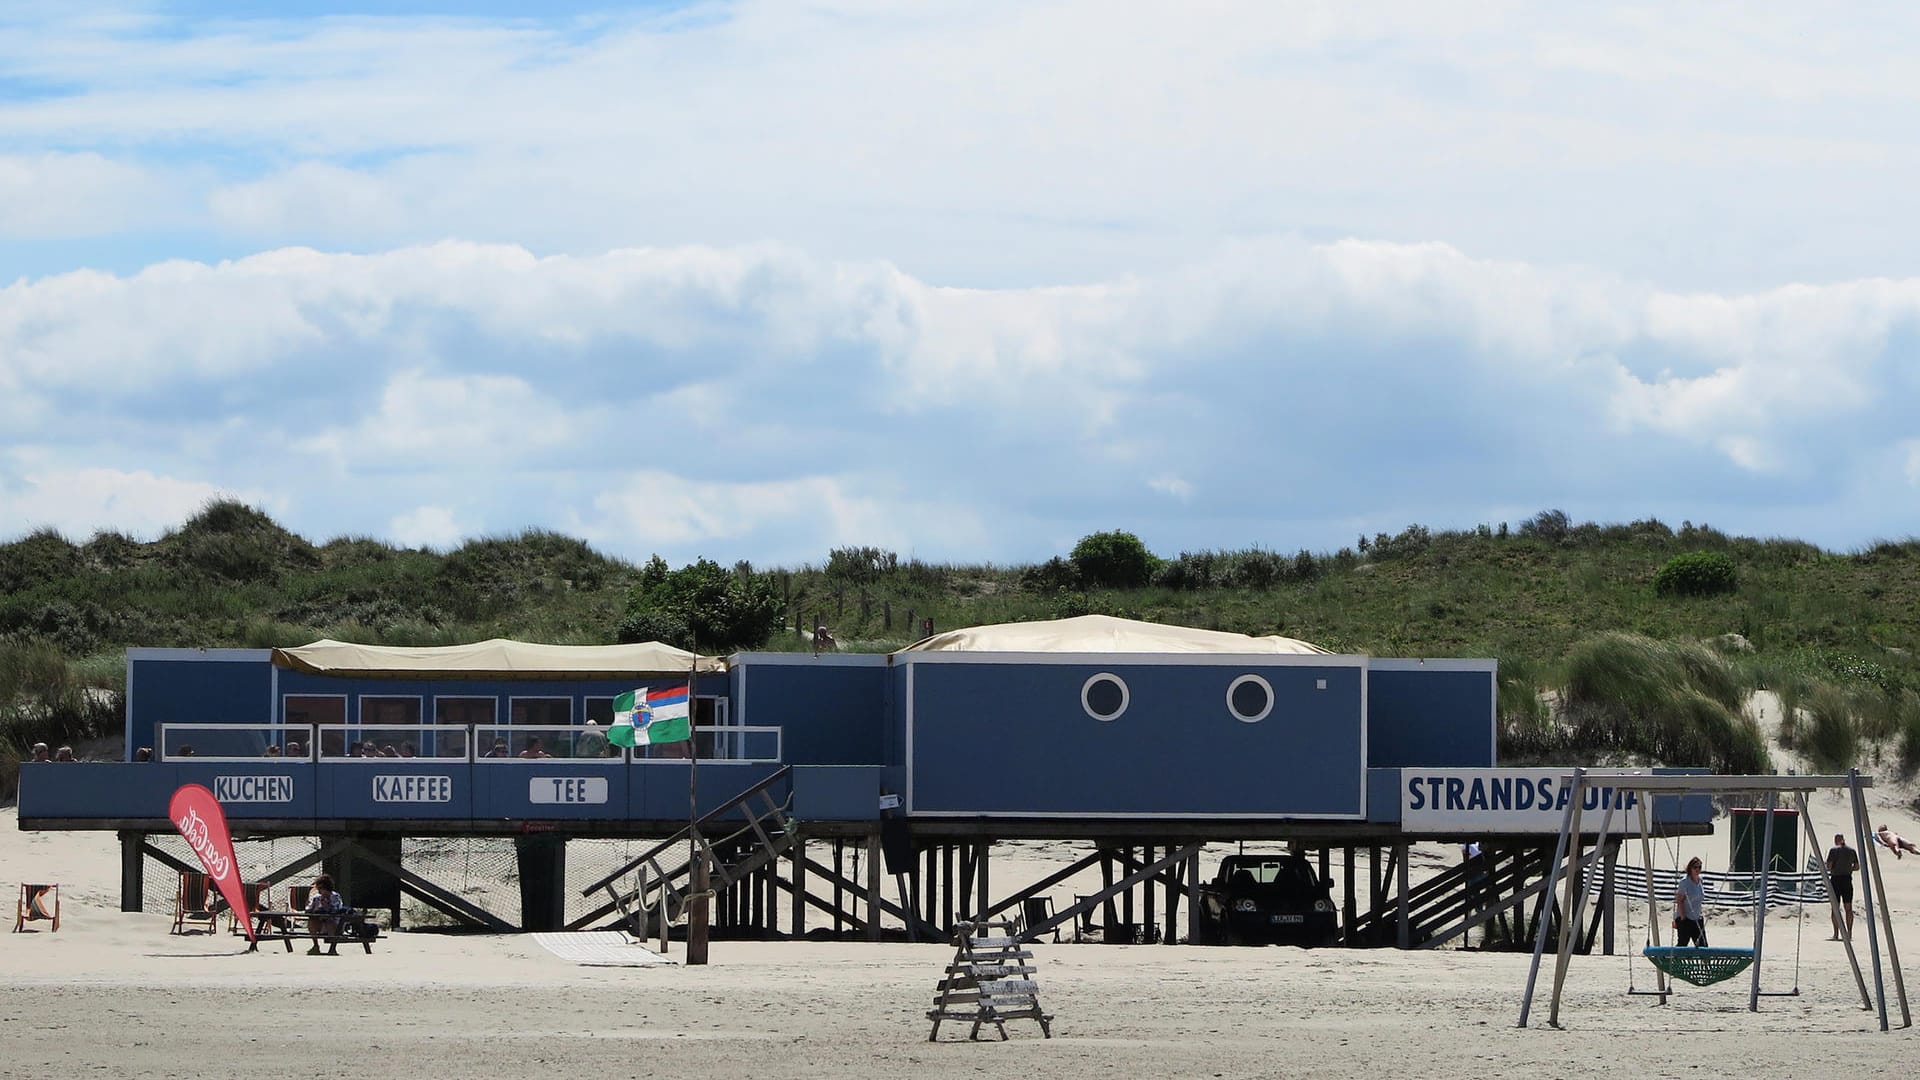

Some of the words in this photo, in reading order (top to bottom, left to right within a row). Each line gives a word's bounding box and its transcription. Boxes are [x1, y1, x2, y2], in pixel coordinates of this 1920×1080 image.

[217, 777, 292, 801] KUCHEN
[376, 777, 448, 801] KAFFEE
[552, 779, 586, 802] TEE
